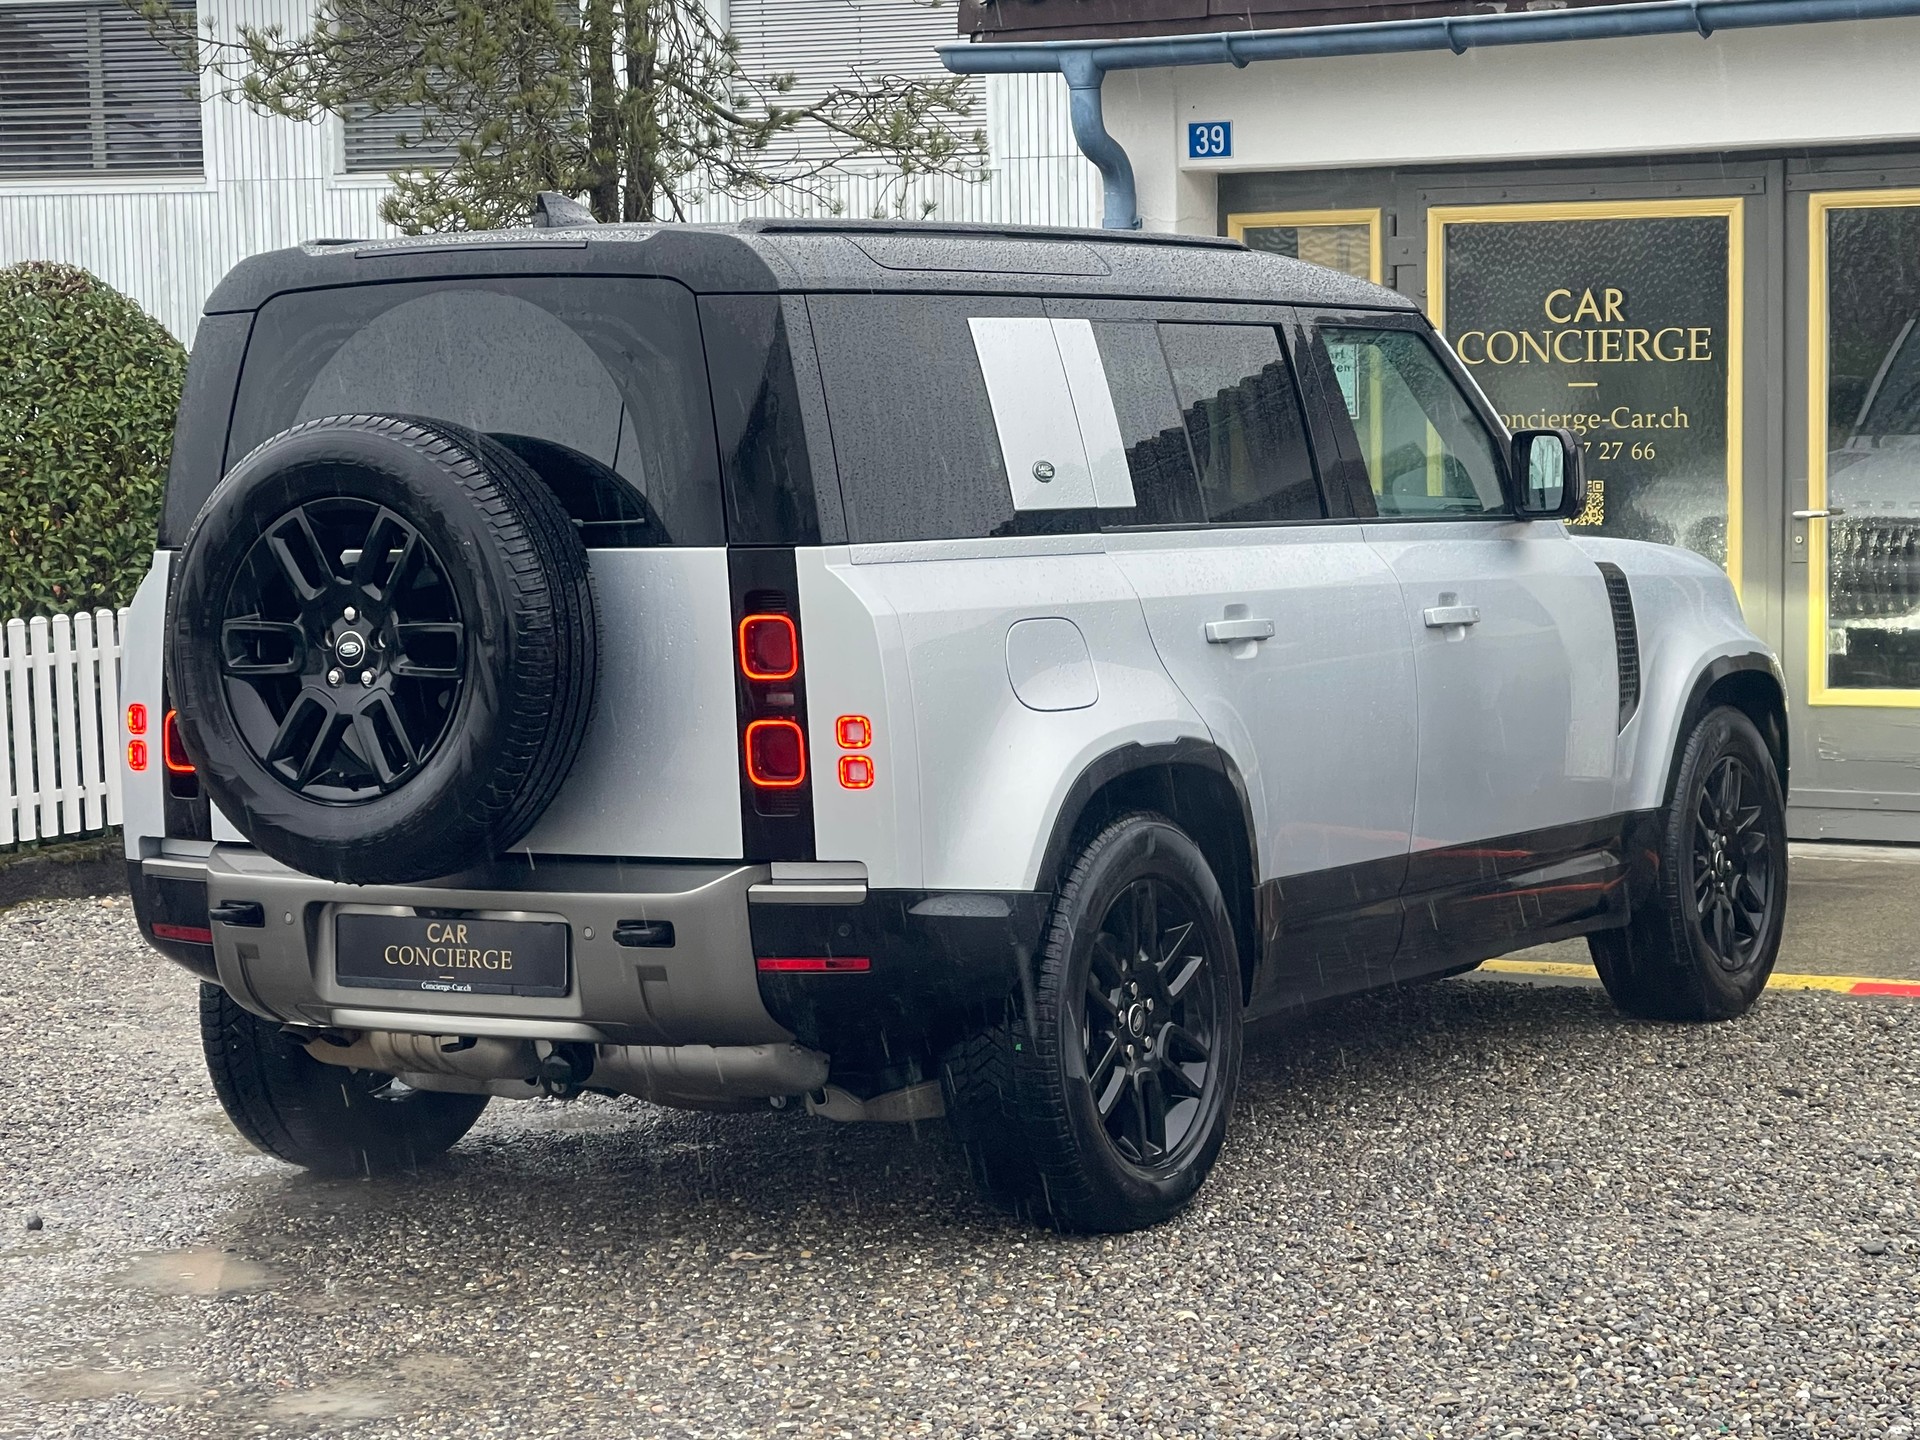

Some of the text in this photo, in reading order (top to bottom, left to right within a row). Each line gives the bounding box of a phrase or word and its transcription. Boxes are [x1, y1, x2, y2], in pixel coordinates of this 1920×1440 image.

[1196, 125, 1225, 154] 39
[1544, 287, 1625, 323] CAR
[1457, 327, 1712, 365] CONCIERGE
[1500, 406, 1690, 436] oncierge-Car.ch
[1599, 442, 1623, 460] 27
[1631, 441, 1656, 460] 66
[426, 923, 468, 944] CAR
[384, 945, 513, 970] CONCIERGE
